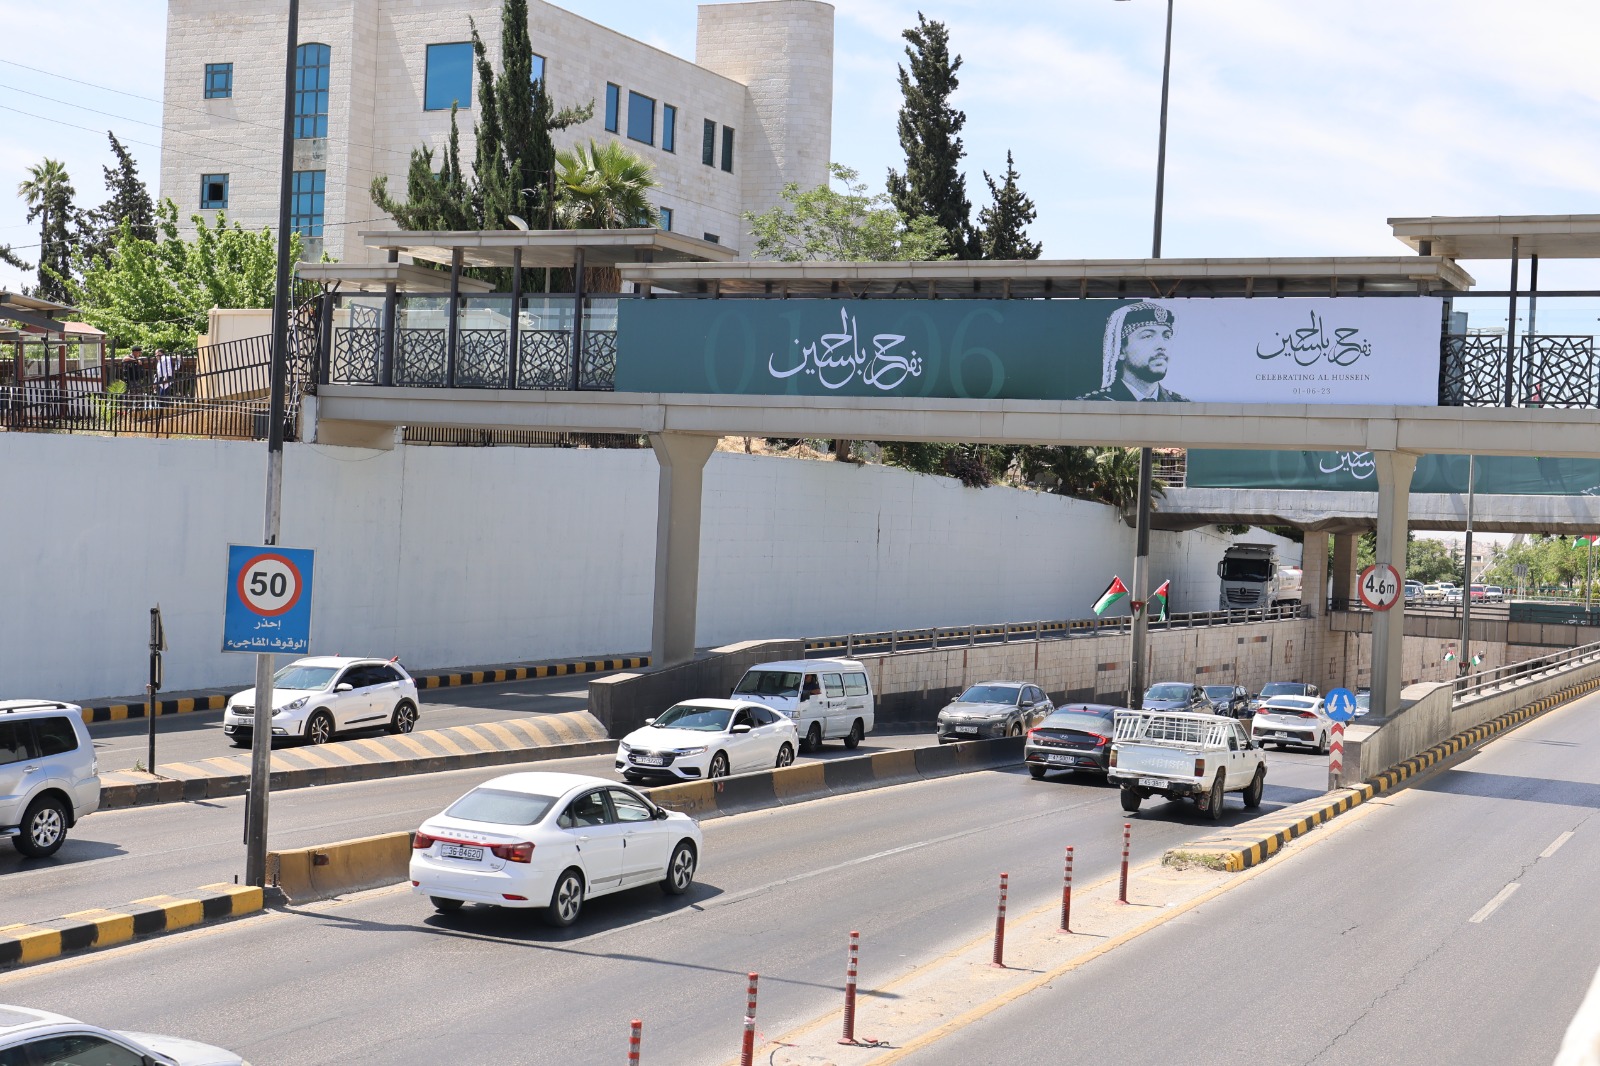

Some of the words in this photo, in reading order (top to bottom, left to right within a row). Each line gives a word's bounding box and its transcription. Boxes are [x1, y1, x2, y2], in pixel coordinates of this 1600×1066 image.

[768, 306, 867, 390] بالحسين
[1256, 309, 1330, 367] بالحسين
[1292, 387, 1331, 395] 01-06-23
[250, 571, 287, 598] 50
[1365, 574, 1395, 595] 4.6m
[270, 637, 307, 650] الوقوف
